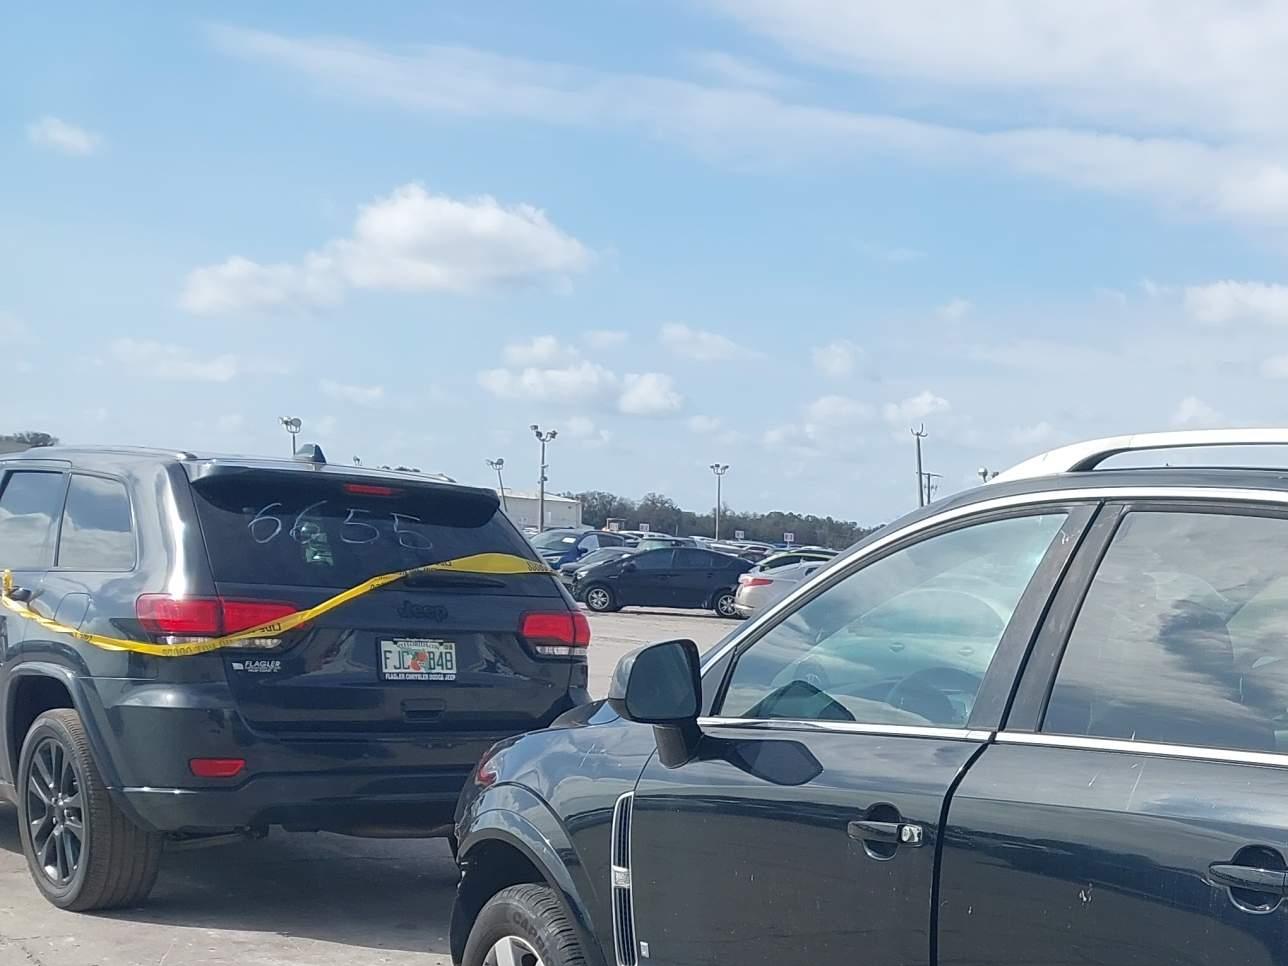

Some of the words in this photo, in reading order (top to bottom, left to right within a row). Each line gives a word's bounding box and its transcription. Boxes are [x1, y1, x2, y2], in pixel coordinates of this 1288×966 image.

[247, 500, 433, 551] 6655
[397, 600, 449, 622] Jeep
[245, 660, 281, 668] FLAGLER
[383, 650, 410, 670] FJC
